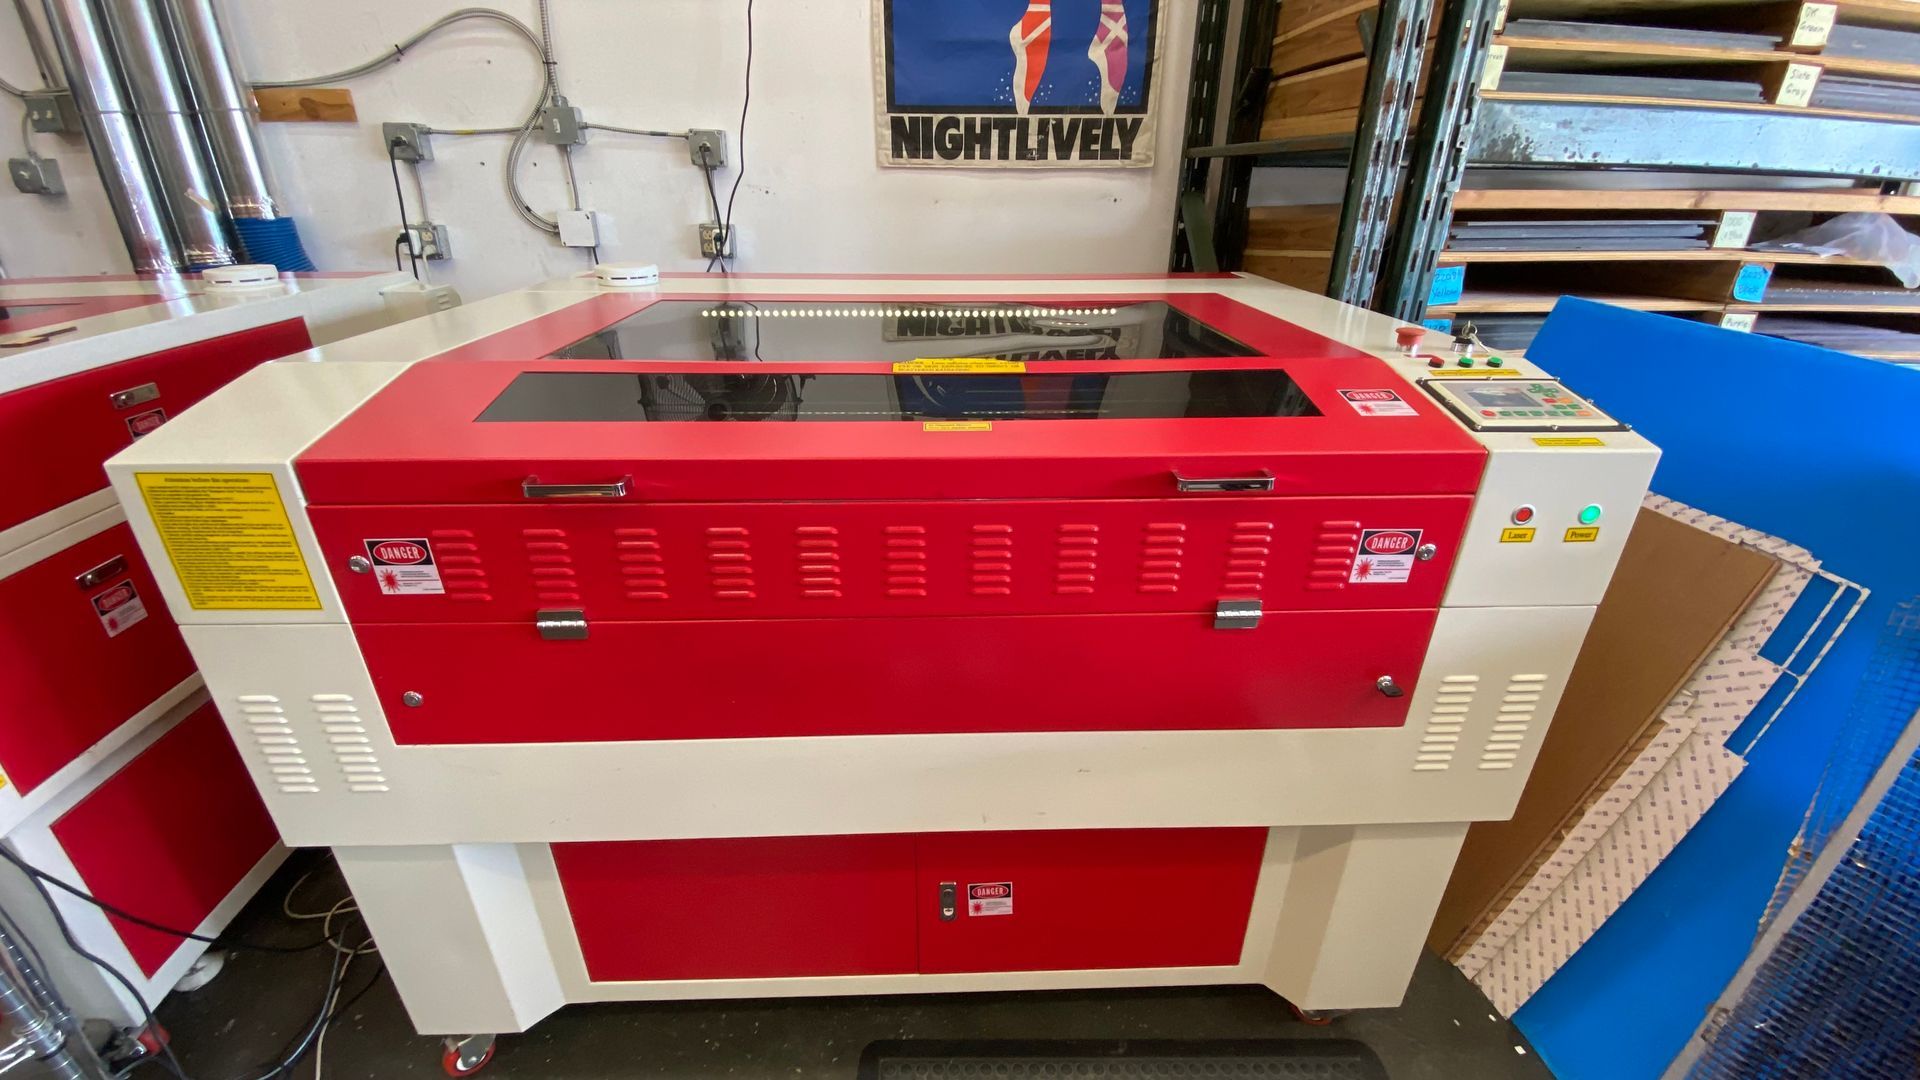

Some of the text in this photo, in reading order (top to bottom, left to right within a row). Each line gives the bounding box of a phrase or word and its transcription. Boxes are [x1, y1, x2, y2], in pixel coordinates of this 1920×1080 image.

[1799, 21, 1824, 32] Green
[1789, 69, 1811, 80] Slate
[890, 115, 1144, 161] NIGHTLIVELY
[1725, 318, 1748, 328] Purple
[1351, 391, 1391, 400] DANGER
[1507, 531, 1528, 539] Laser
[1570, 531, 1592, 539] Power
[1371, 537, 1409, 549] DANGER
[380, 546, 420, 560] DANGER
[977, 887, 1004, 896] DANGER
